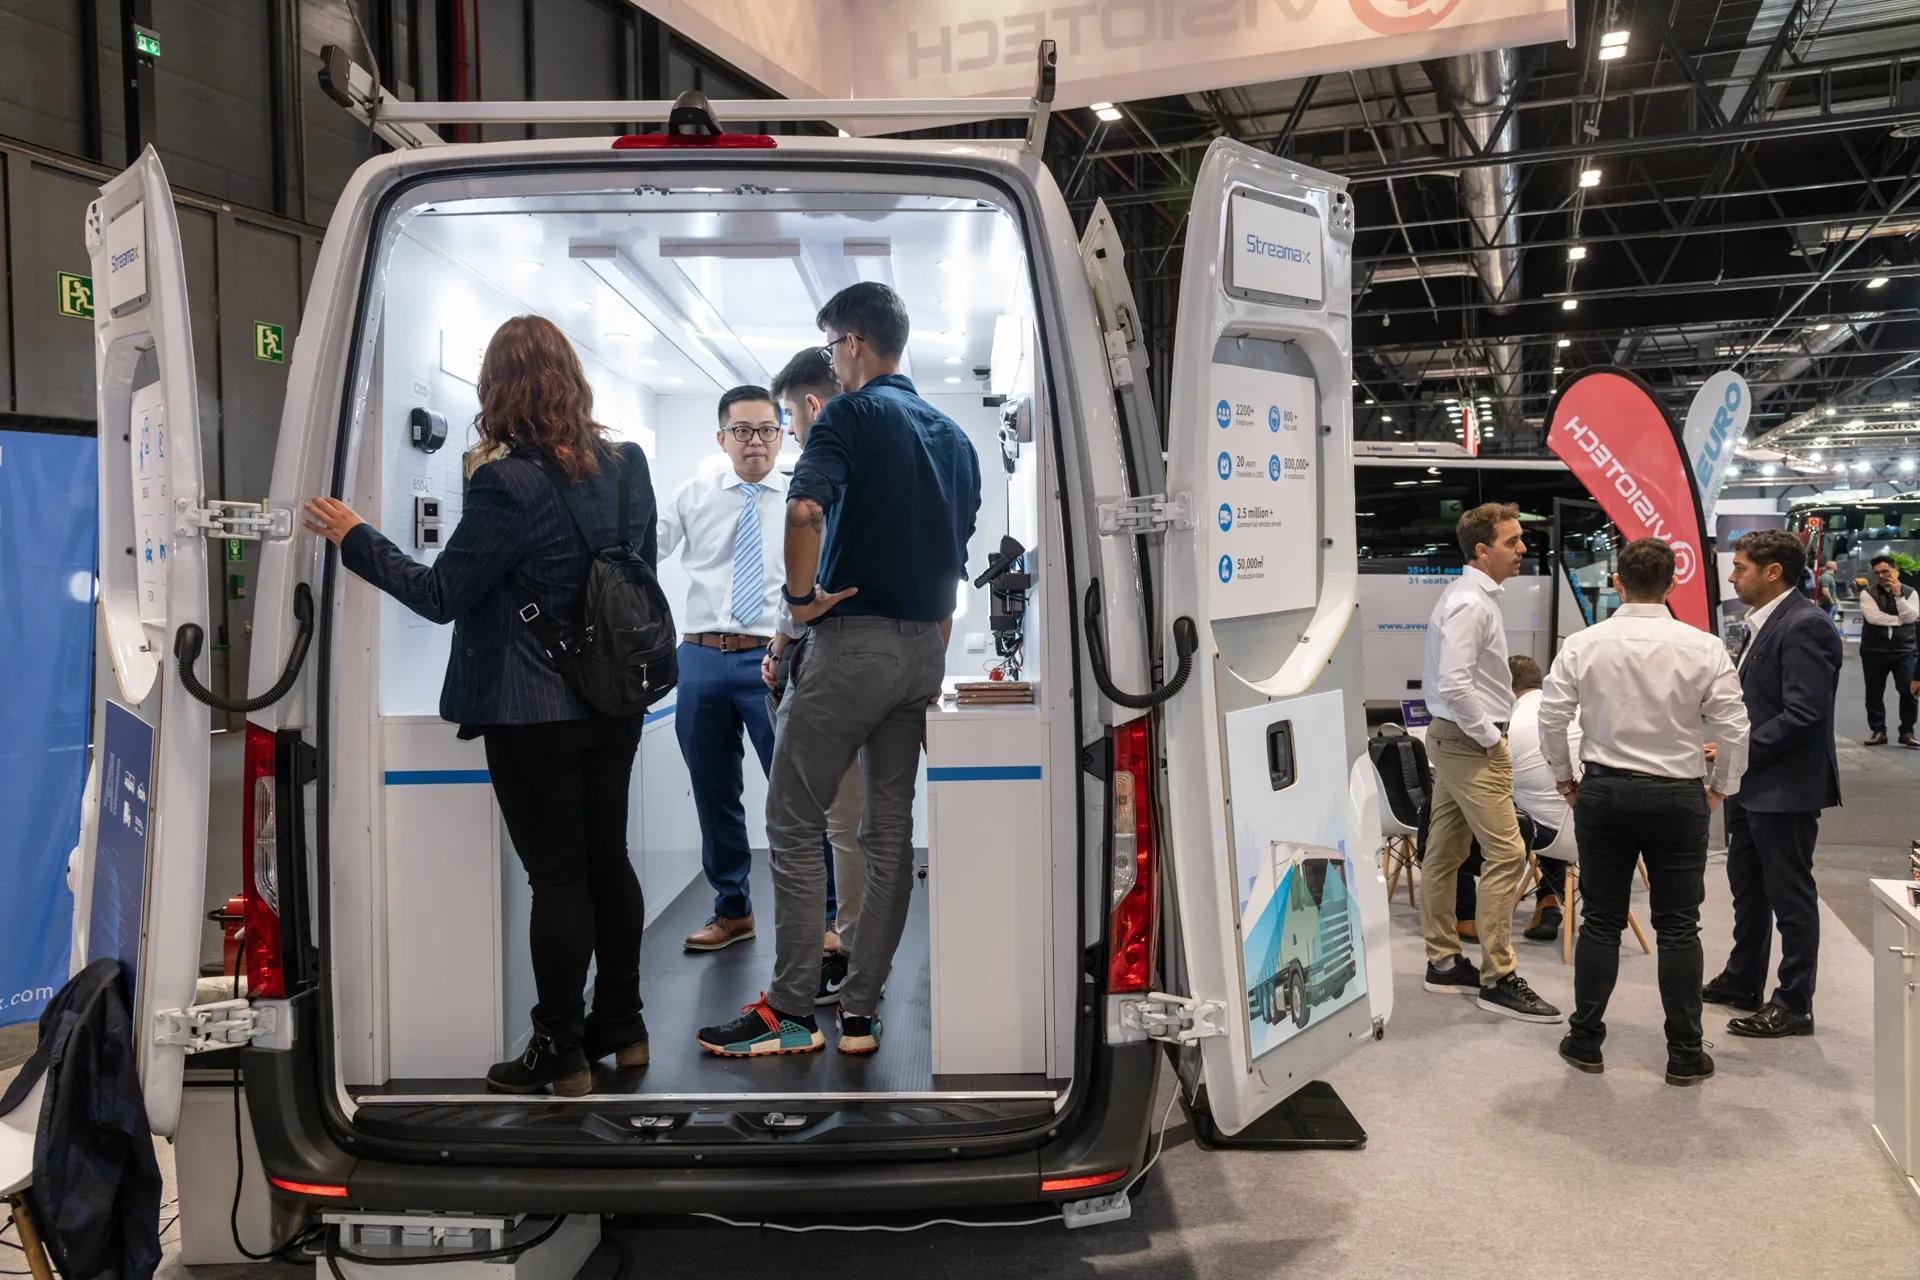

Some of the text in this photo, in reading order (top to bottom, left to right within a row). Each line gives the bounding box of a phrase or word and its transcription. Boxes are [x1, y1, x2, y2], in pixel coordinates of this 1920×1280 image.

[1246, 233, 1311, 265] Streamax
[111, 243, 139, 273] Streamax
[1235, 404, 1255, 417] 2200+
[1283, 411, 1293, 422] 800
[1695, 382, 1741, 489] EURO
[1236, 456, 1244, 467] 20
[1284, 458, 1309, 470] 800,000+
[1237, 508, 1247, 519] 2.5
[1248, 507, 1269, 519] million
